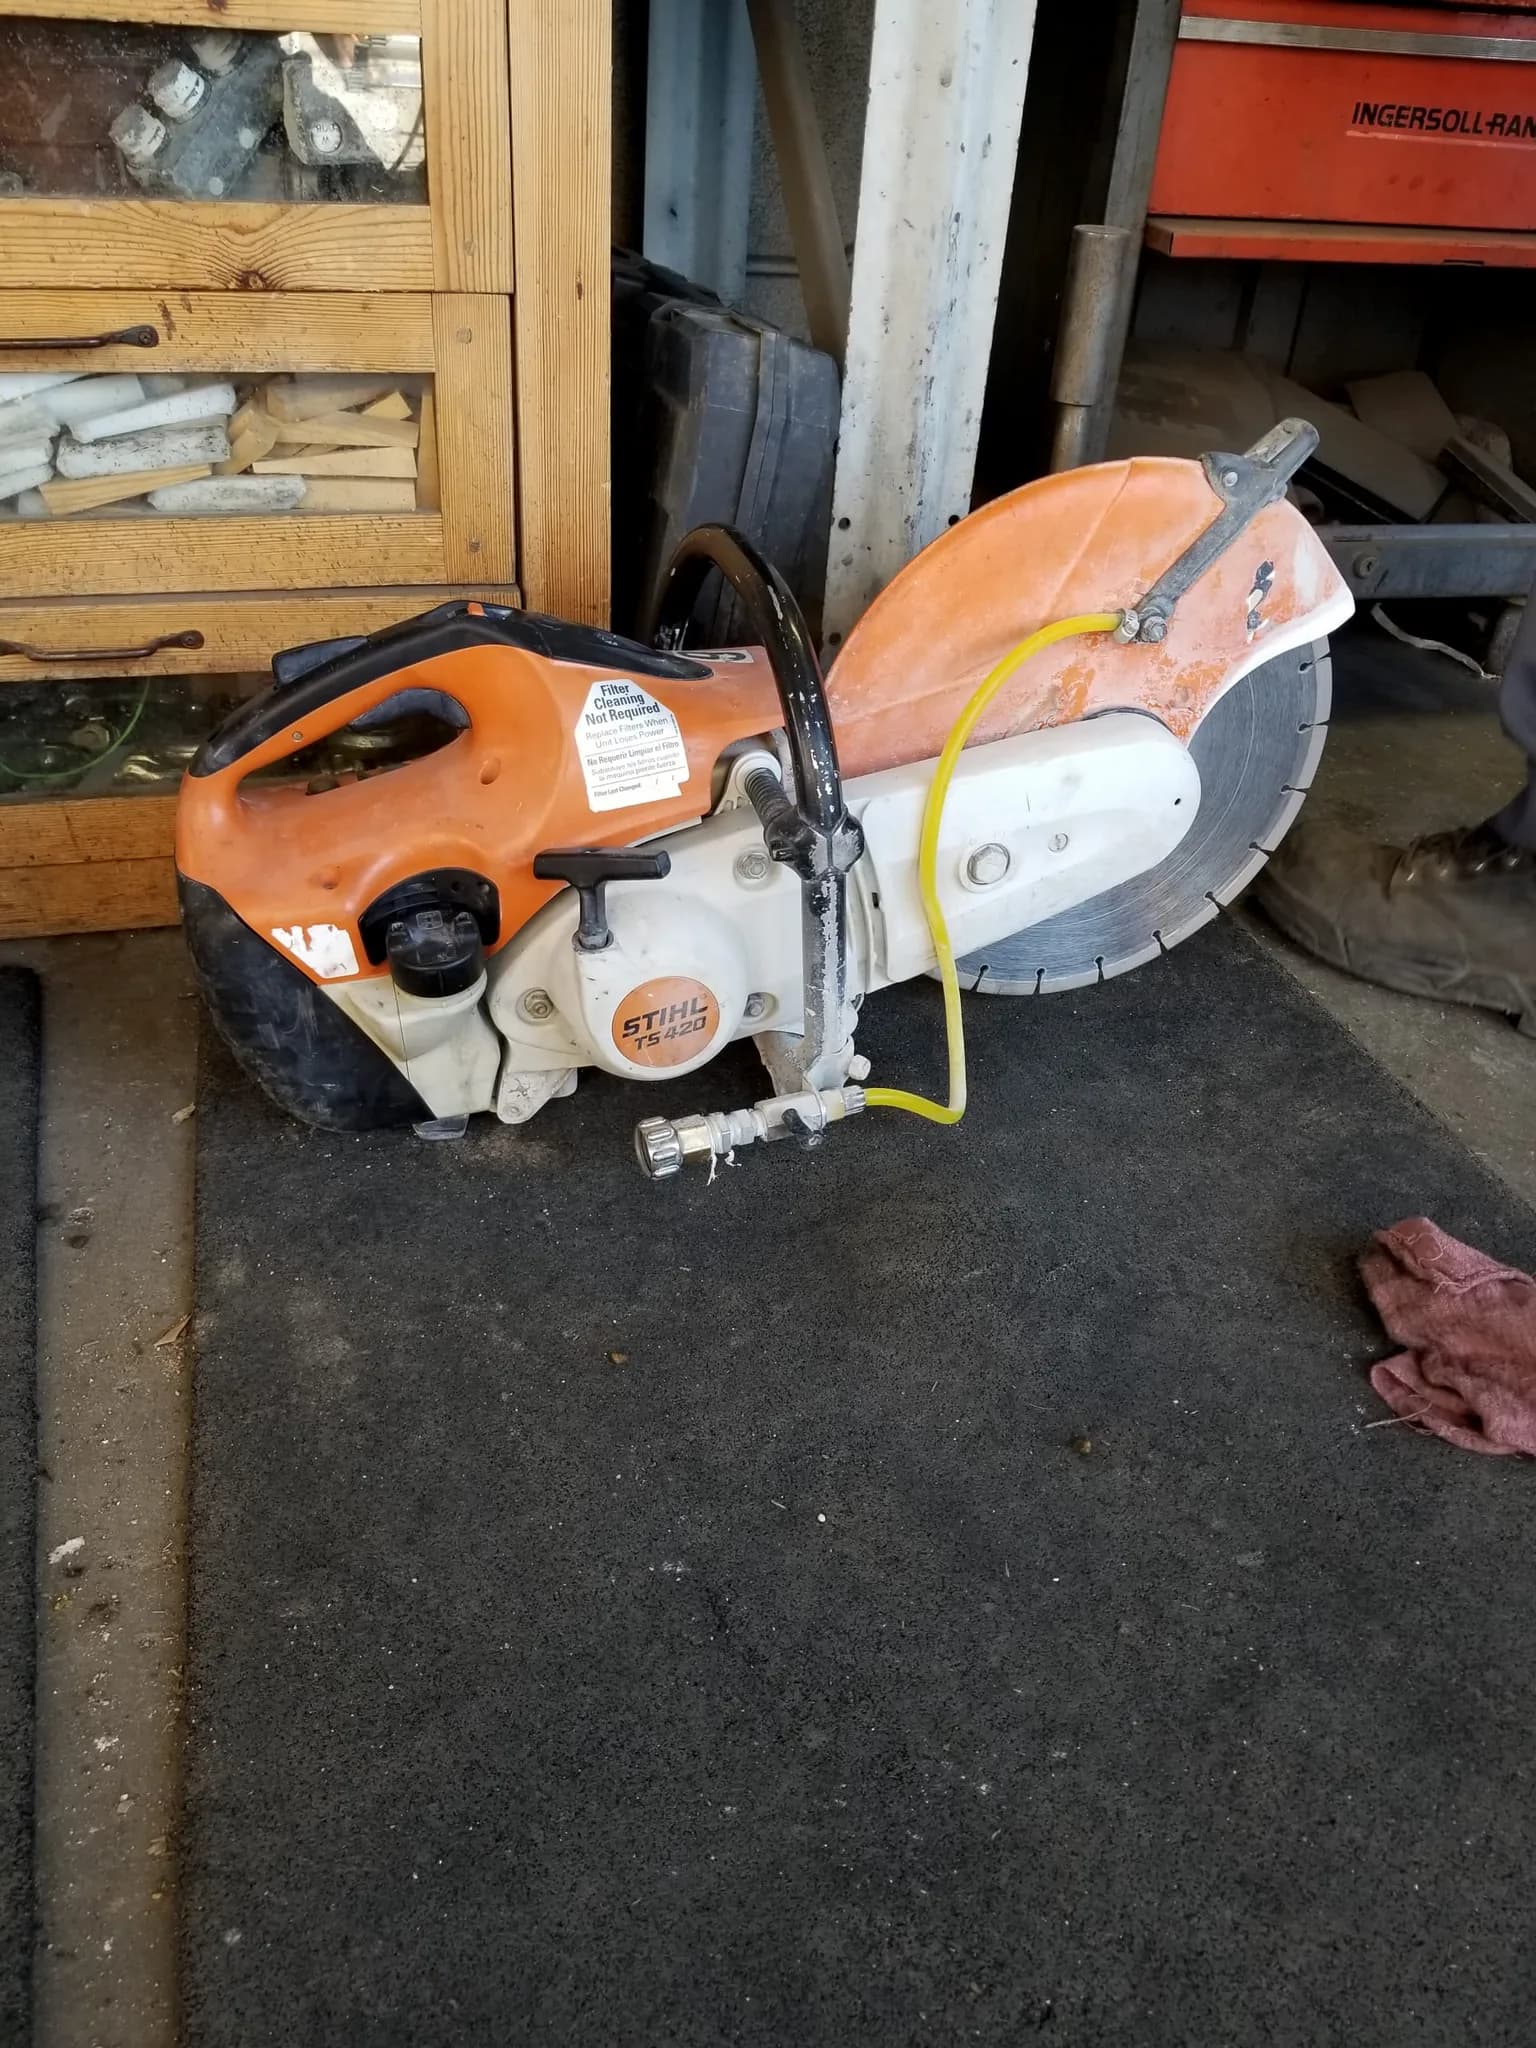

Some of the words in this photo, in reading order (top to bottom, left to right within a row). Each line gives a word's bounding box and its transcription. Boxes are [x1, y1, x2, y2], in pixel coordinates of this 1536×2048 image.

[600, 683, 630, 697] Filter
[593, 693, 646, 710] Cleaning
[585, 712, 608, 727] Not
[608, 701, 661, 721] Required
[585, 728, 618, 741] Replace
[618, 722, 644, 733] Filters
[644, 717, 669, 728] When
[595, 738, 613, 749] Unit
[638, 728, 664, 739] Power
[662, 741, 680, 751] Filtro
[622, 997, 708, 1039] STIHL
[634, 1031, 661, 1050] TS
[664, 1015, 707, 1040] 420
